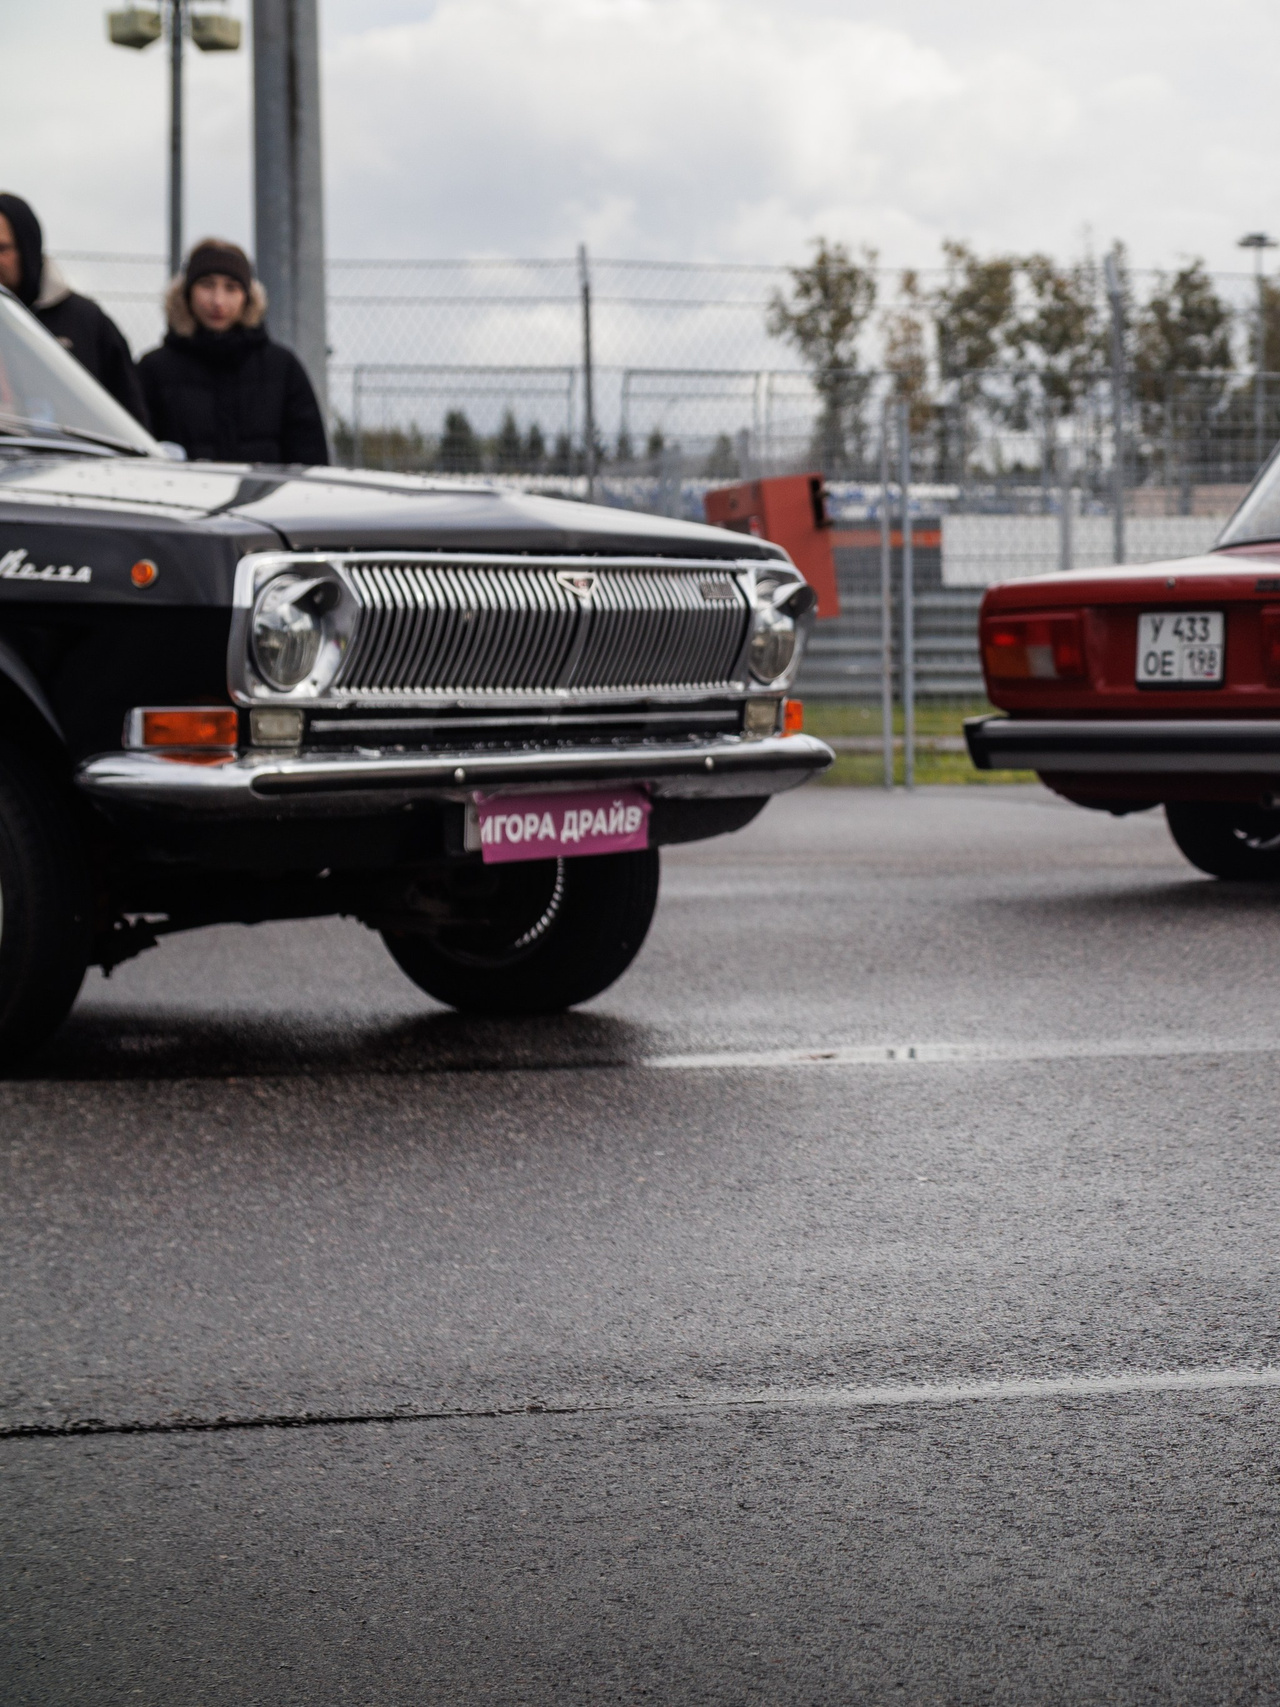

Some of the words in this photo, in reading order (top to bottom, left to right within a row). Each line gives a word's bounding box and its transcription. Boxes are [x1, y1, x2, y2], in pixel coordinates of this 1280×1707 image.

[1172, 616, 1210, 643] 433
[481, 812, 556, 844] ИГОРА
[560, 800, 643, 844] ДРАЙВ
